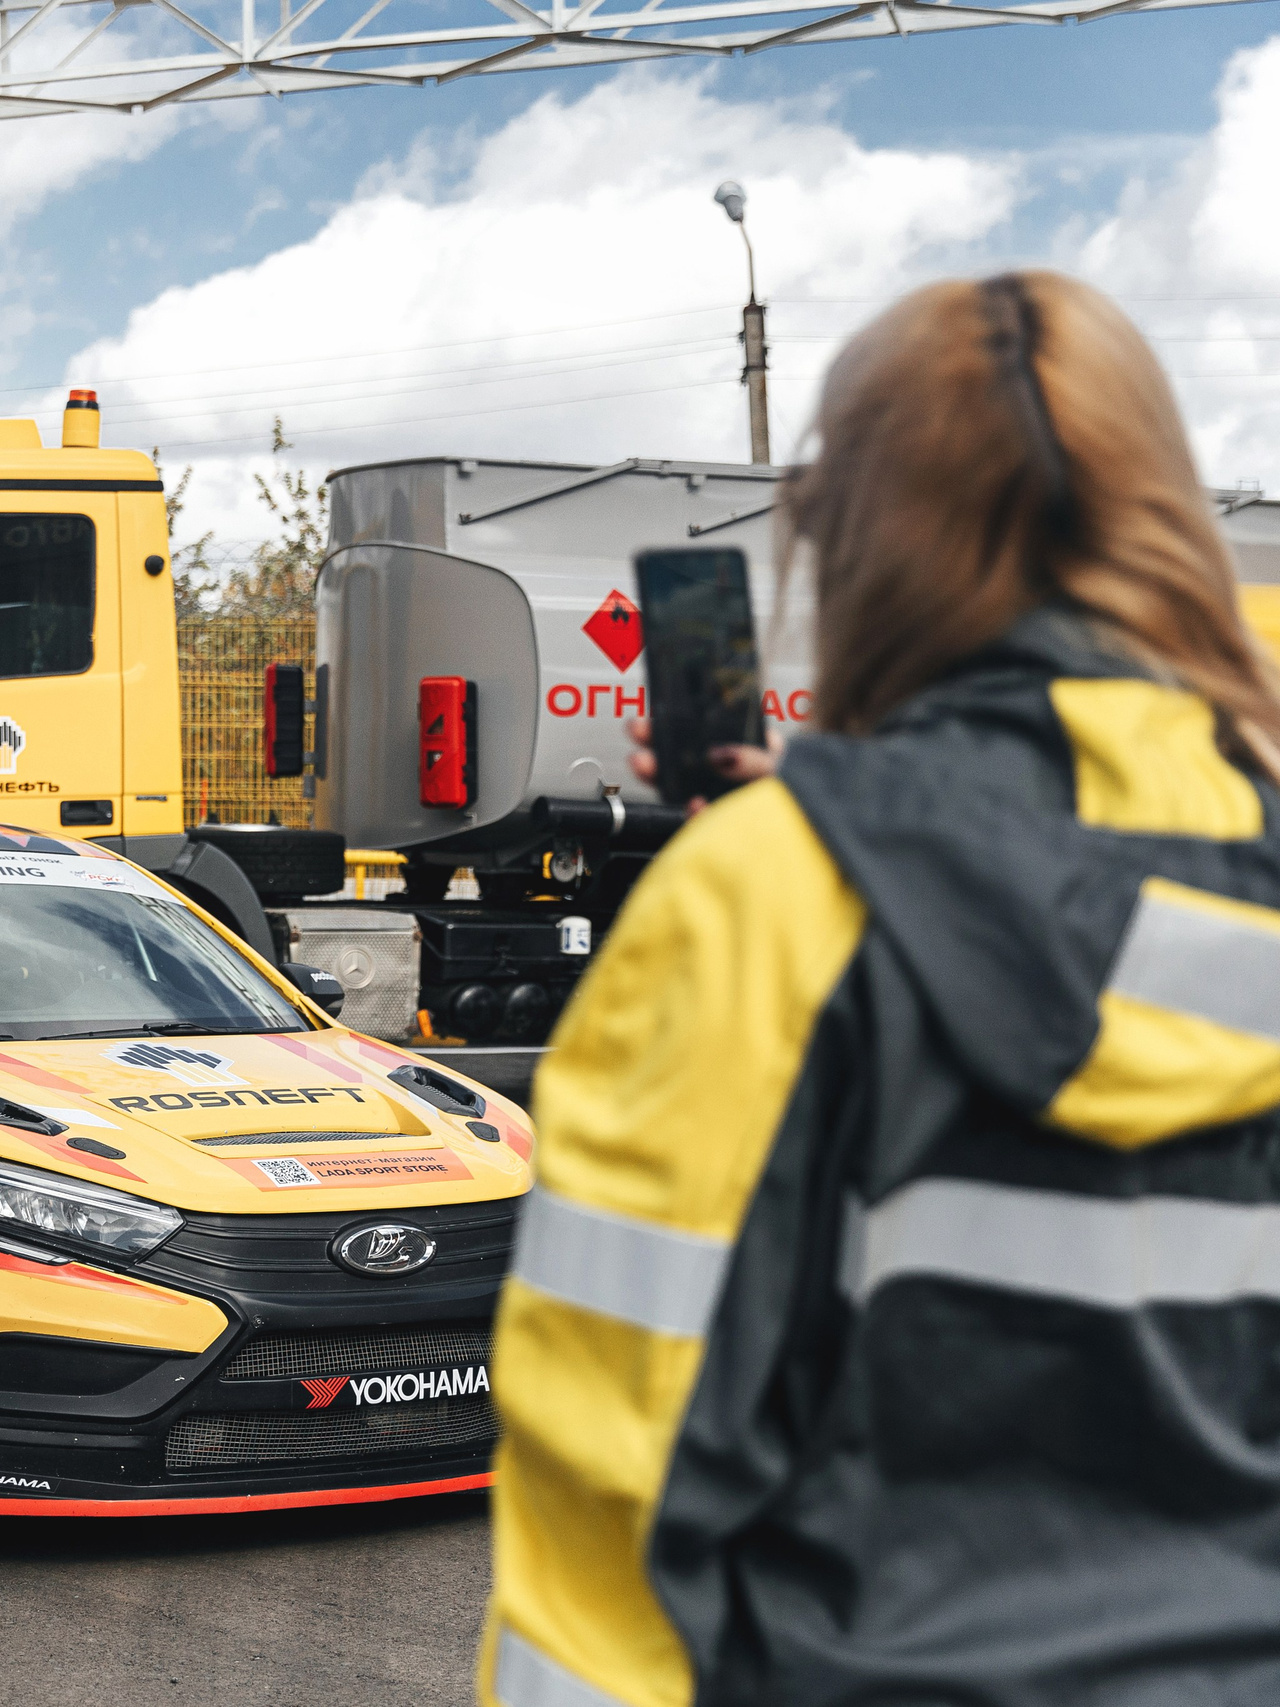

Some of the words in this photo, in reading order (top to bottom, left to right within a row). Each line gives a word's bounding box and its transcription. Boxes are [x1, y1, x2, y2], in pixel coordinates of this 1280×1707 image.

[22, 856, 63, 865] гонок
[107, 1087, 366, 1113] ROSNEFT
[307, 1156, 436, 1167] интернет-магазин
[317, 1167, 356, 1178] LADA
[356, 1166, 401, 1175] SPORT
[403, 1164, 449, 1172] STORE
[349, 1365, 491, 1406] YOKOHAMA
